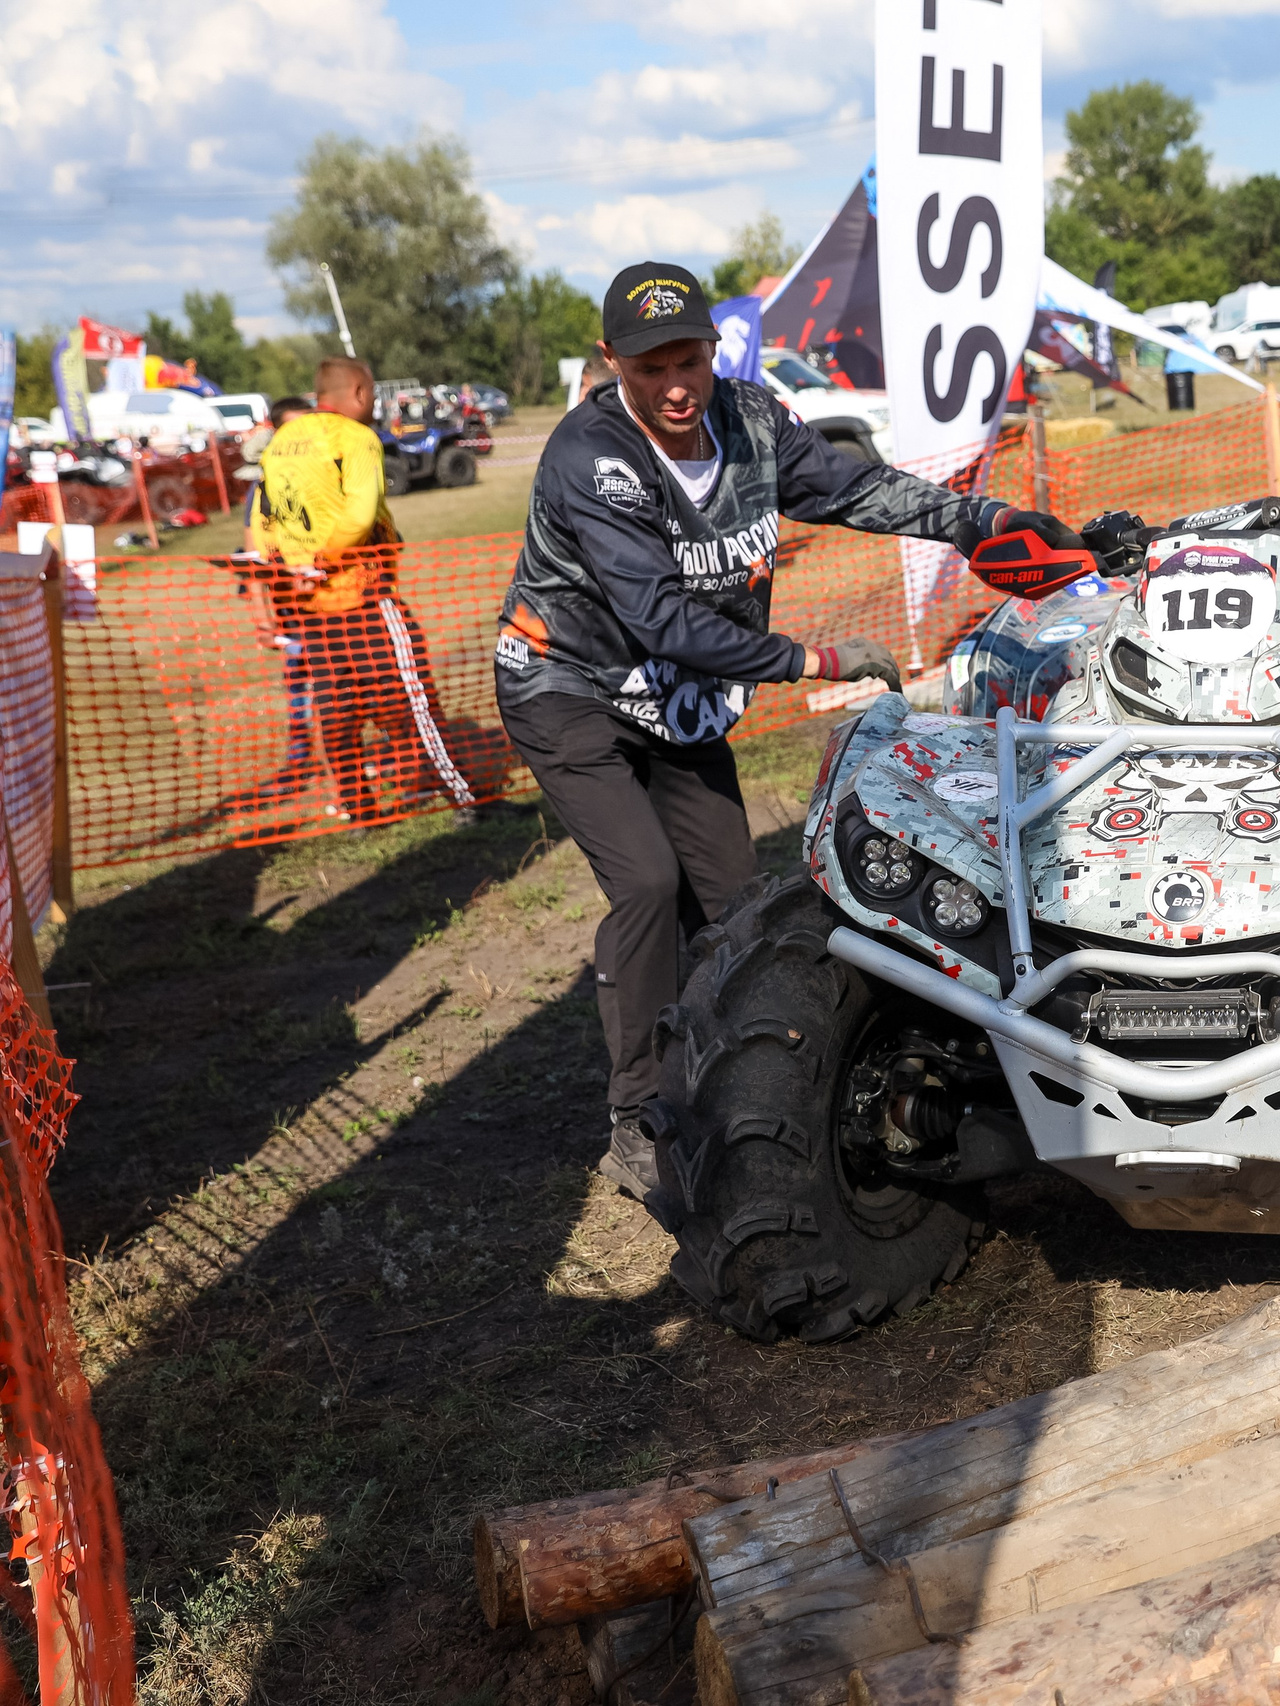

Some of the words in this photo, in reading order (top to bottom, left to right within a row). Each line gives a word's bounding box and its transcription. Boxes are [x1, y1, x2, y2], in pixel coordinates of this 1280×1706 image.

[989, 570, 1045, 584] can-am
[1161, 588, 1254, 632] 119
[1172, 897, 1203, 907] BRP
